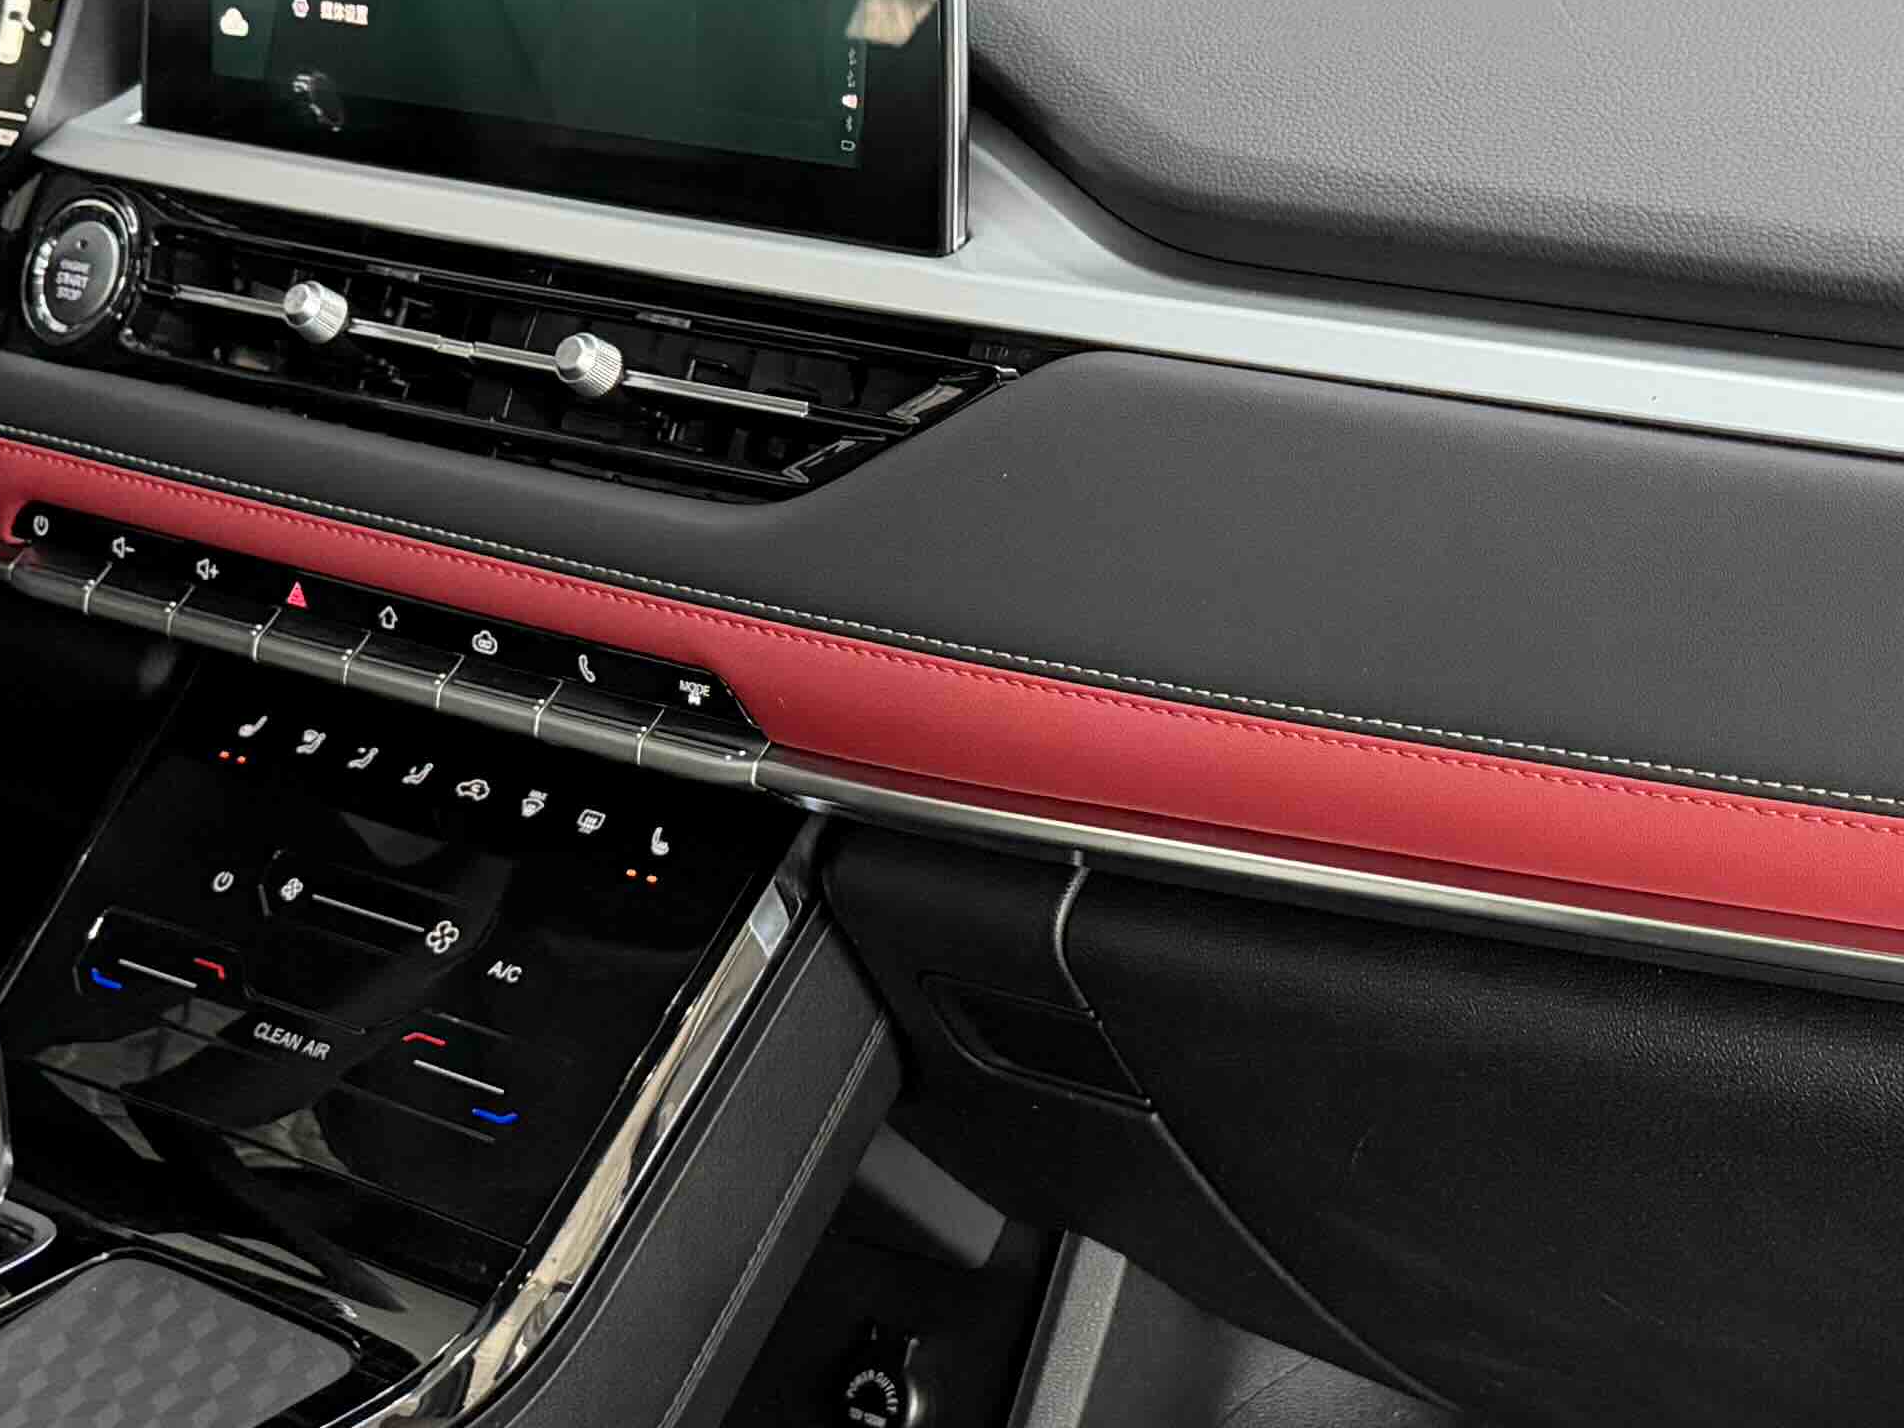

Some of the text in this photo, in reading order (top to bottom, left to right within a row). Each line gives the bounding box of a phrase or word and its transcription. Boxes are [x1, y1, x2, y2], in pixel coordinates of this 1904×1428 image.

[319, 0, 369, 26] 媒体设置
[56, 271, 89, 289] START
[56, 286, 83, 301] STOP
[679, 679, 711, 697] MODE
[487, 960, 523, 983] A/C
[253, 1021, 332, 1061] CLEAN AIR
